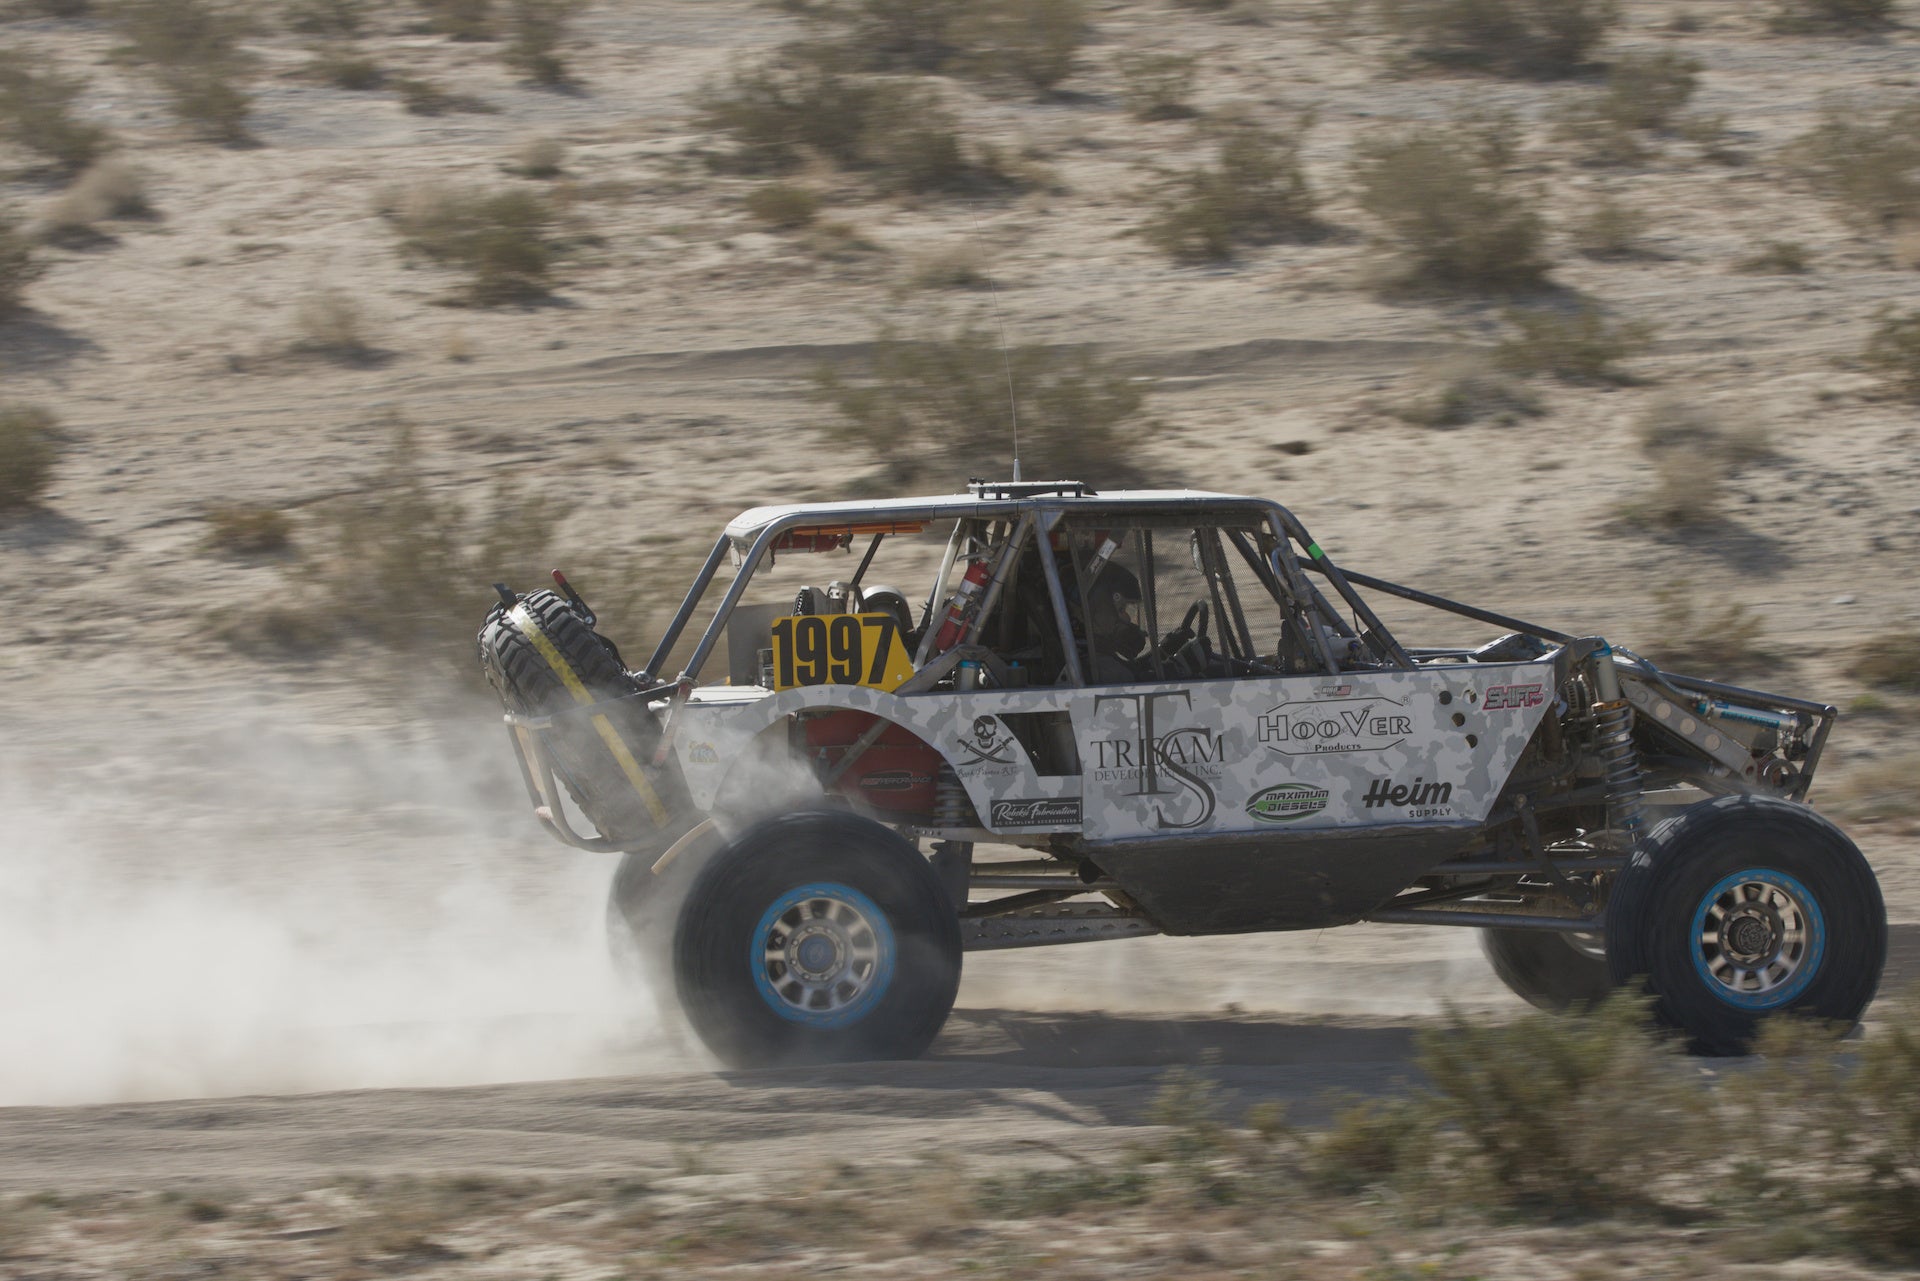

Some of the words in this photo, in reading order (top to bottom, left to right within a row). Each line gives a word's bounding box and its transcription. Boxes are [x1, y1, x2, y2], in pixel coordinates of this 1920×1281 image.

[772, 616, 899, 687] 1997
[1483, 685, 1542, 709] SHIFT
[1195, 765, 1222, 775] INC.
[1266, 790, 1329, 801] MAXIMUM
[1362, 777, 1452, 808] Heim
[1028, 801, 1077, 819] Fabrication
[1268, 801, 1327, 812] DIESELS
[1409, 808, 1451, 818] SUPPLY
